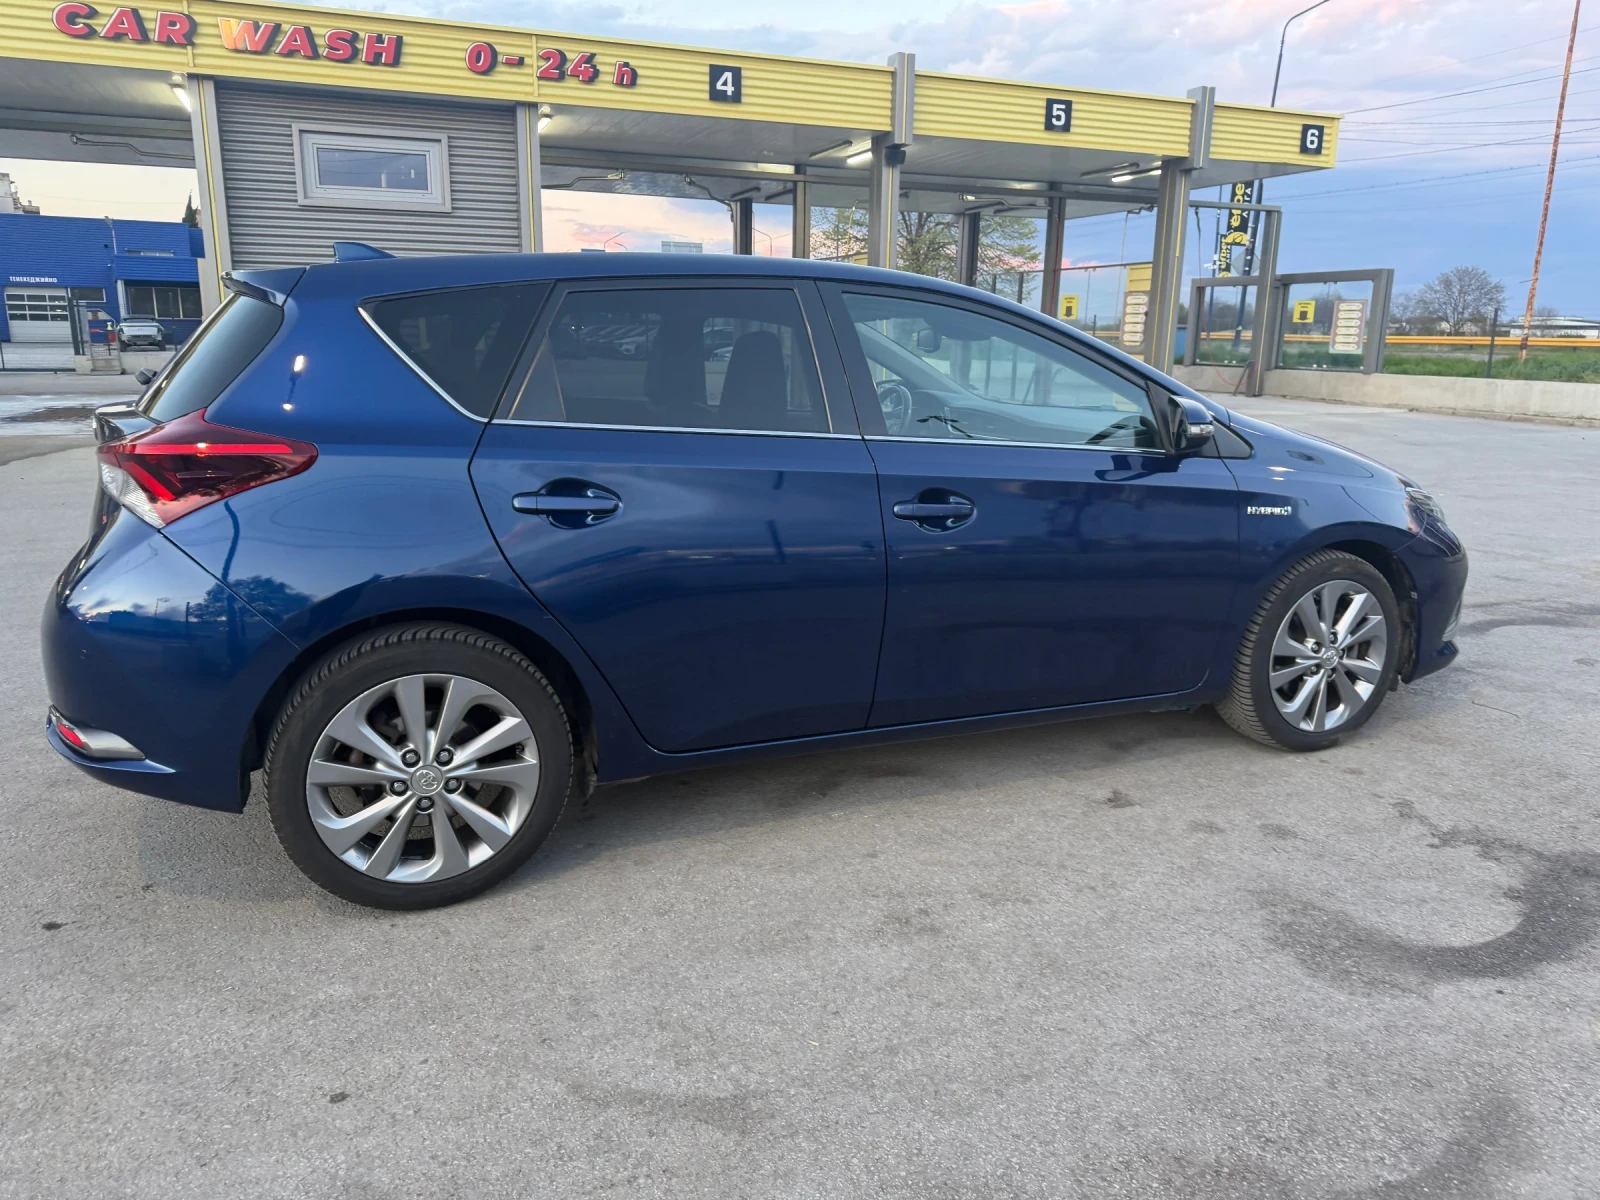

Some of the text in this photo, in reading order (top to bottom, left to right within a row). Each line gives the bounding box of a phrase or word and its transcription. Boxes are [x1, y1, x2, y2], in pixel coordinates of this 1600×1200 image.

[52, 2, 404, 67] CAR WASH
[612, 60, 638, 86] h
[716, 71, 735, 96] 4
[1051, 103, 1066, 126] 5
[1306, 128, 1319, 149] 6
[1242, 187, 1252, 218] ЛГА
